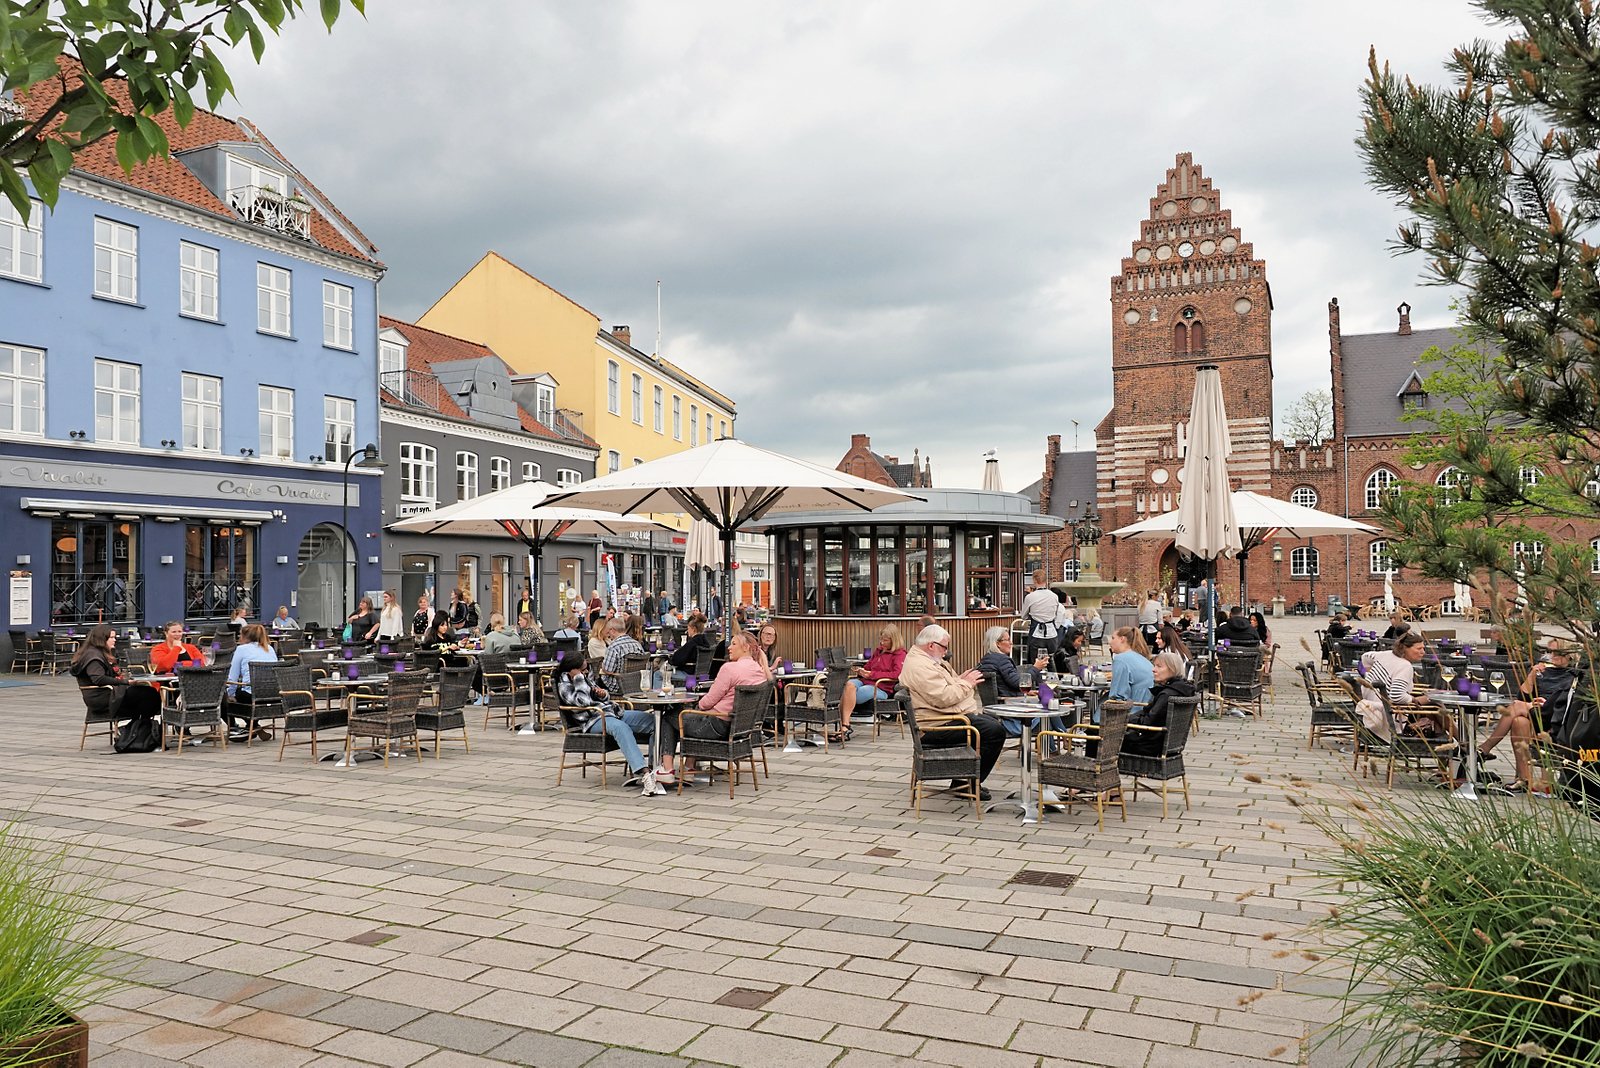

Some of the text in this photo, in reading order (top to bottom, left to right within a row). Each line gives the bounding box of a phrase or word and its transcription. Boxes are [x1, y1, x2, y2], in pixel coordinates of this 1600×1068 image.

[10, 466, 107, 486] Vivaldi
[267, 484, 330, 500] Vivaldi
[1579, 749, 1598, 762] CAT
